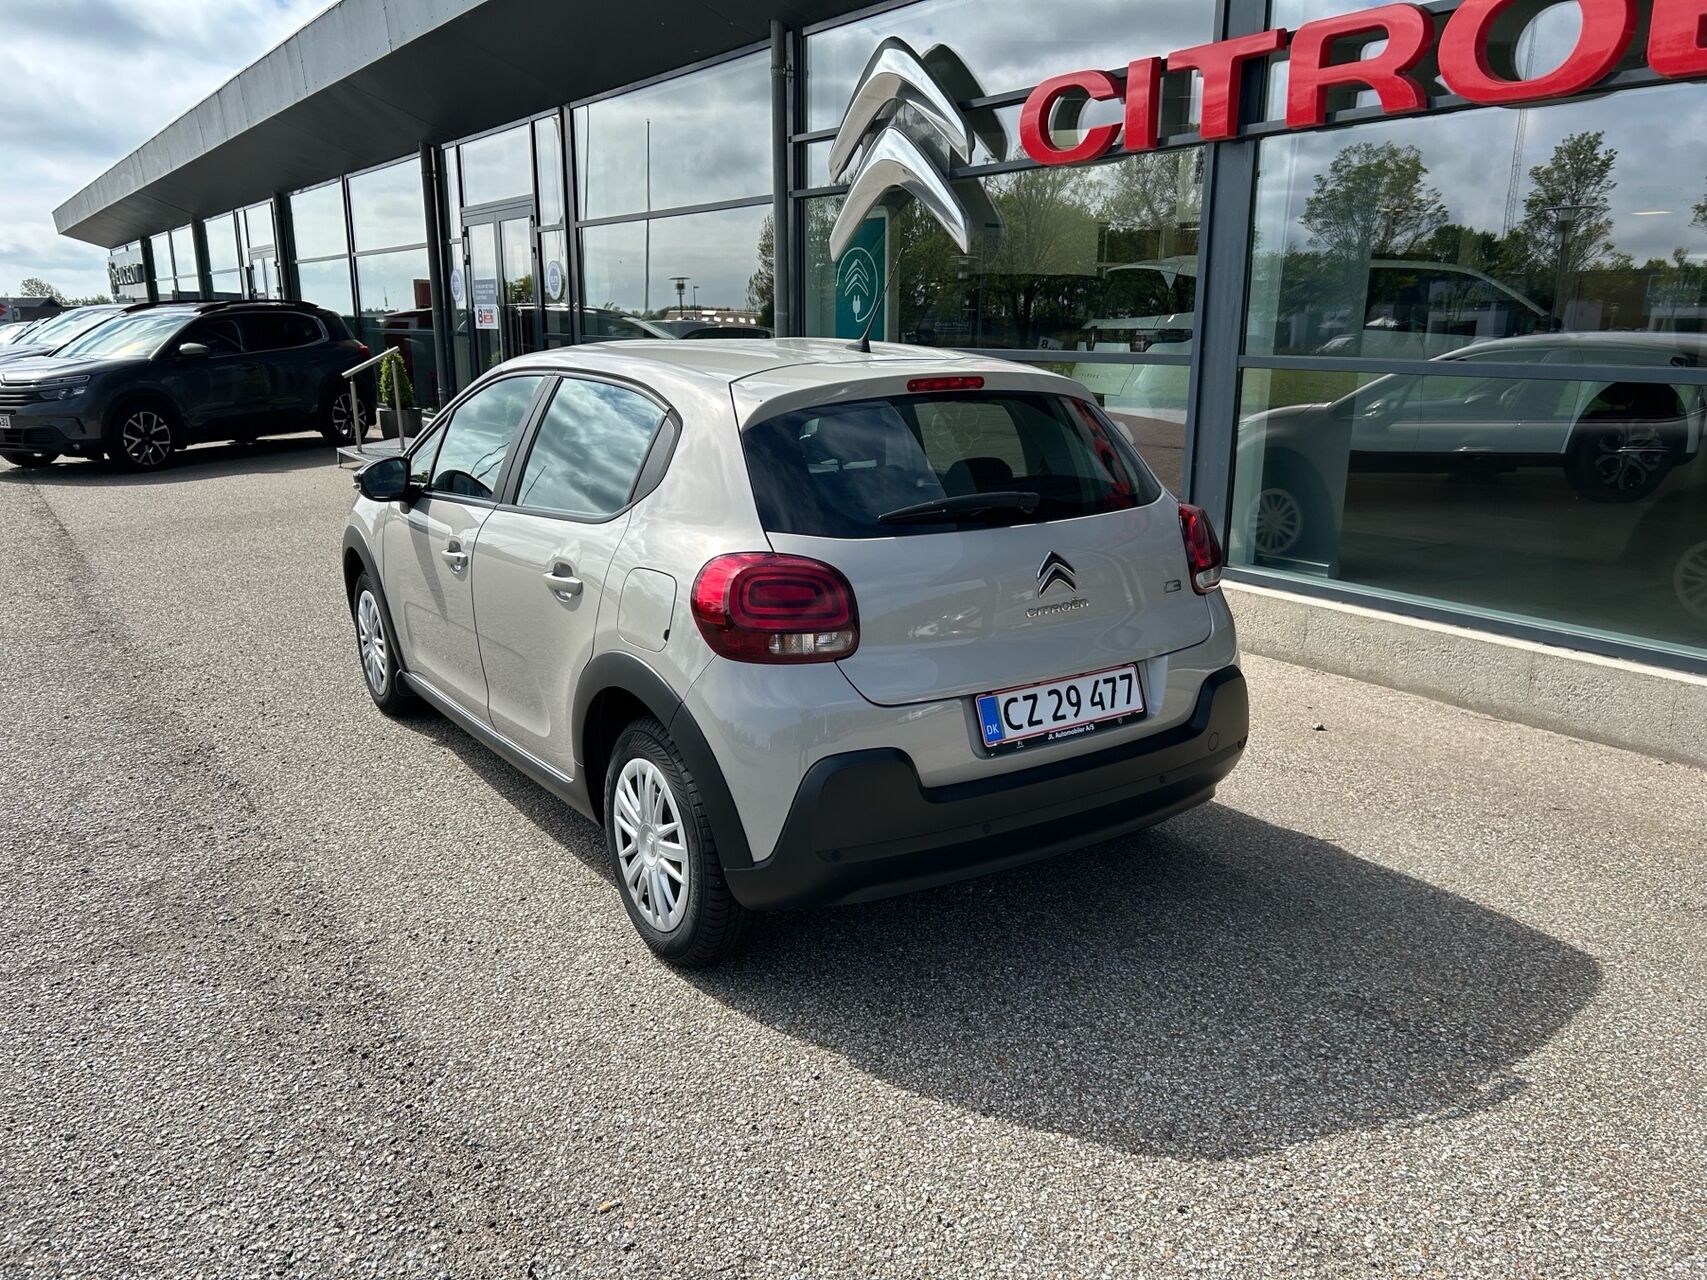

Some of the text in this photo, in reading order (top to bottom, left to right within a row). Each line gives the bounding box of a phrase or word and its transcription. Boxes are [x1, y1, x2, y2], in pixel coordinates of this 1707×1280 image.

[1025, 597, 1089, 618] CITROËN
[1003, 672, 1133, 731] CZ 29 477
[986, 724, 1000, 735] DK
